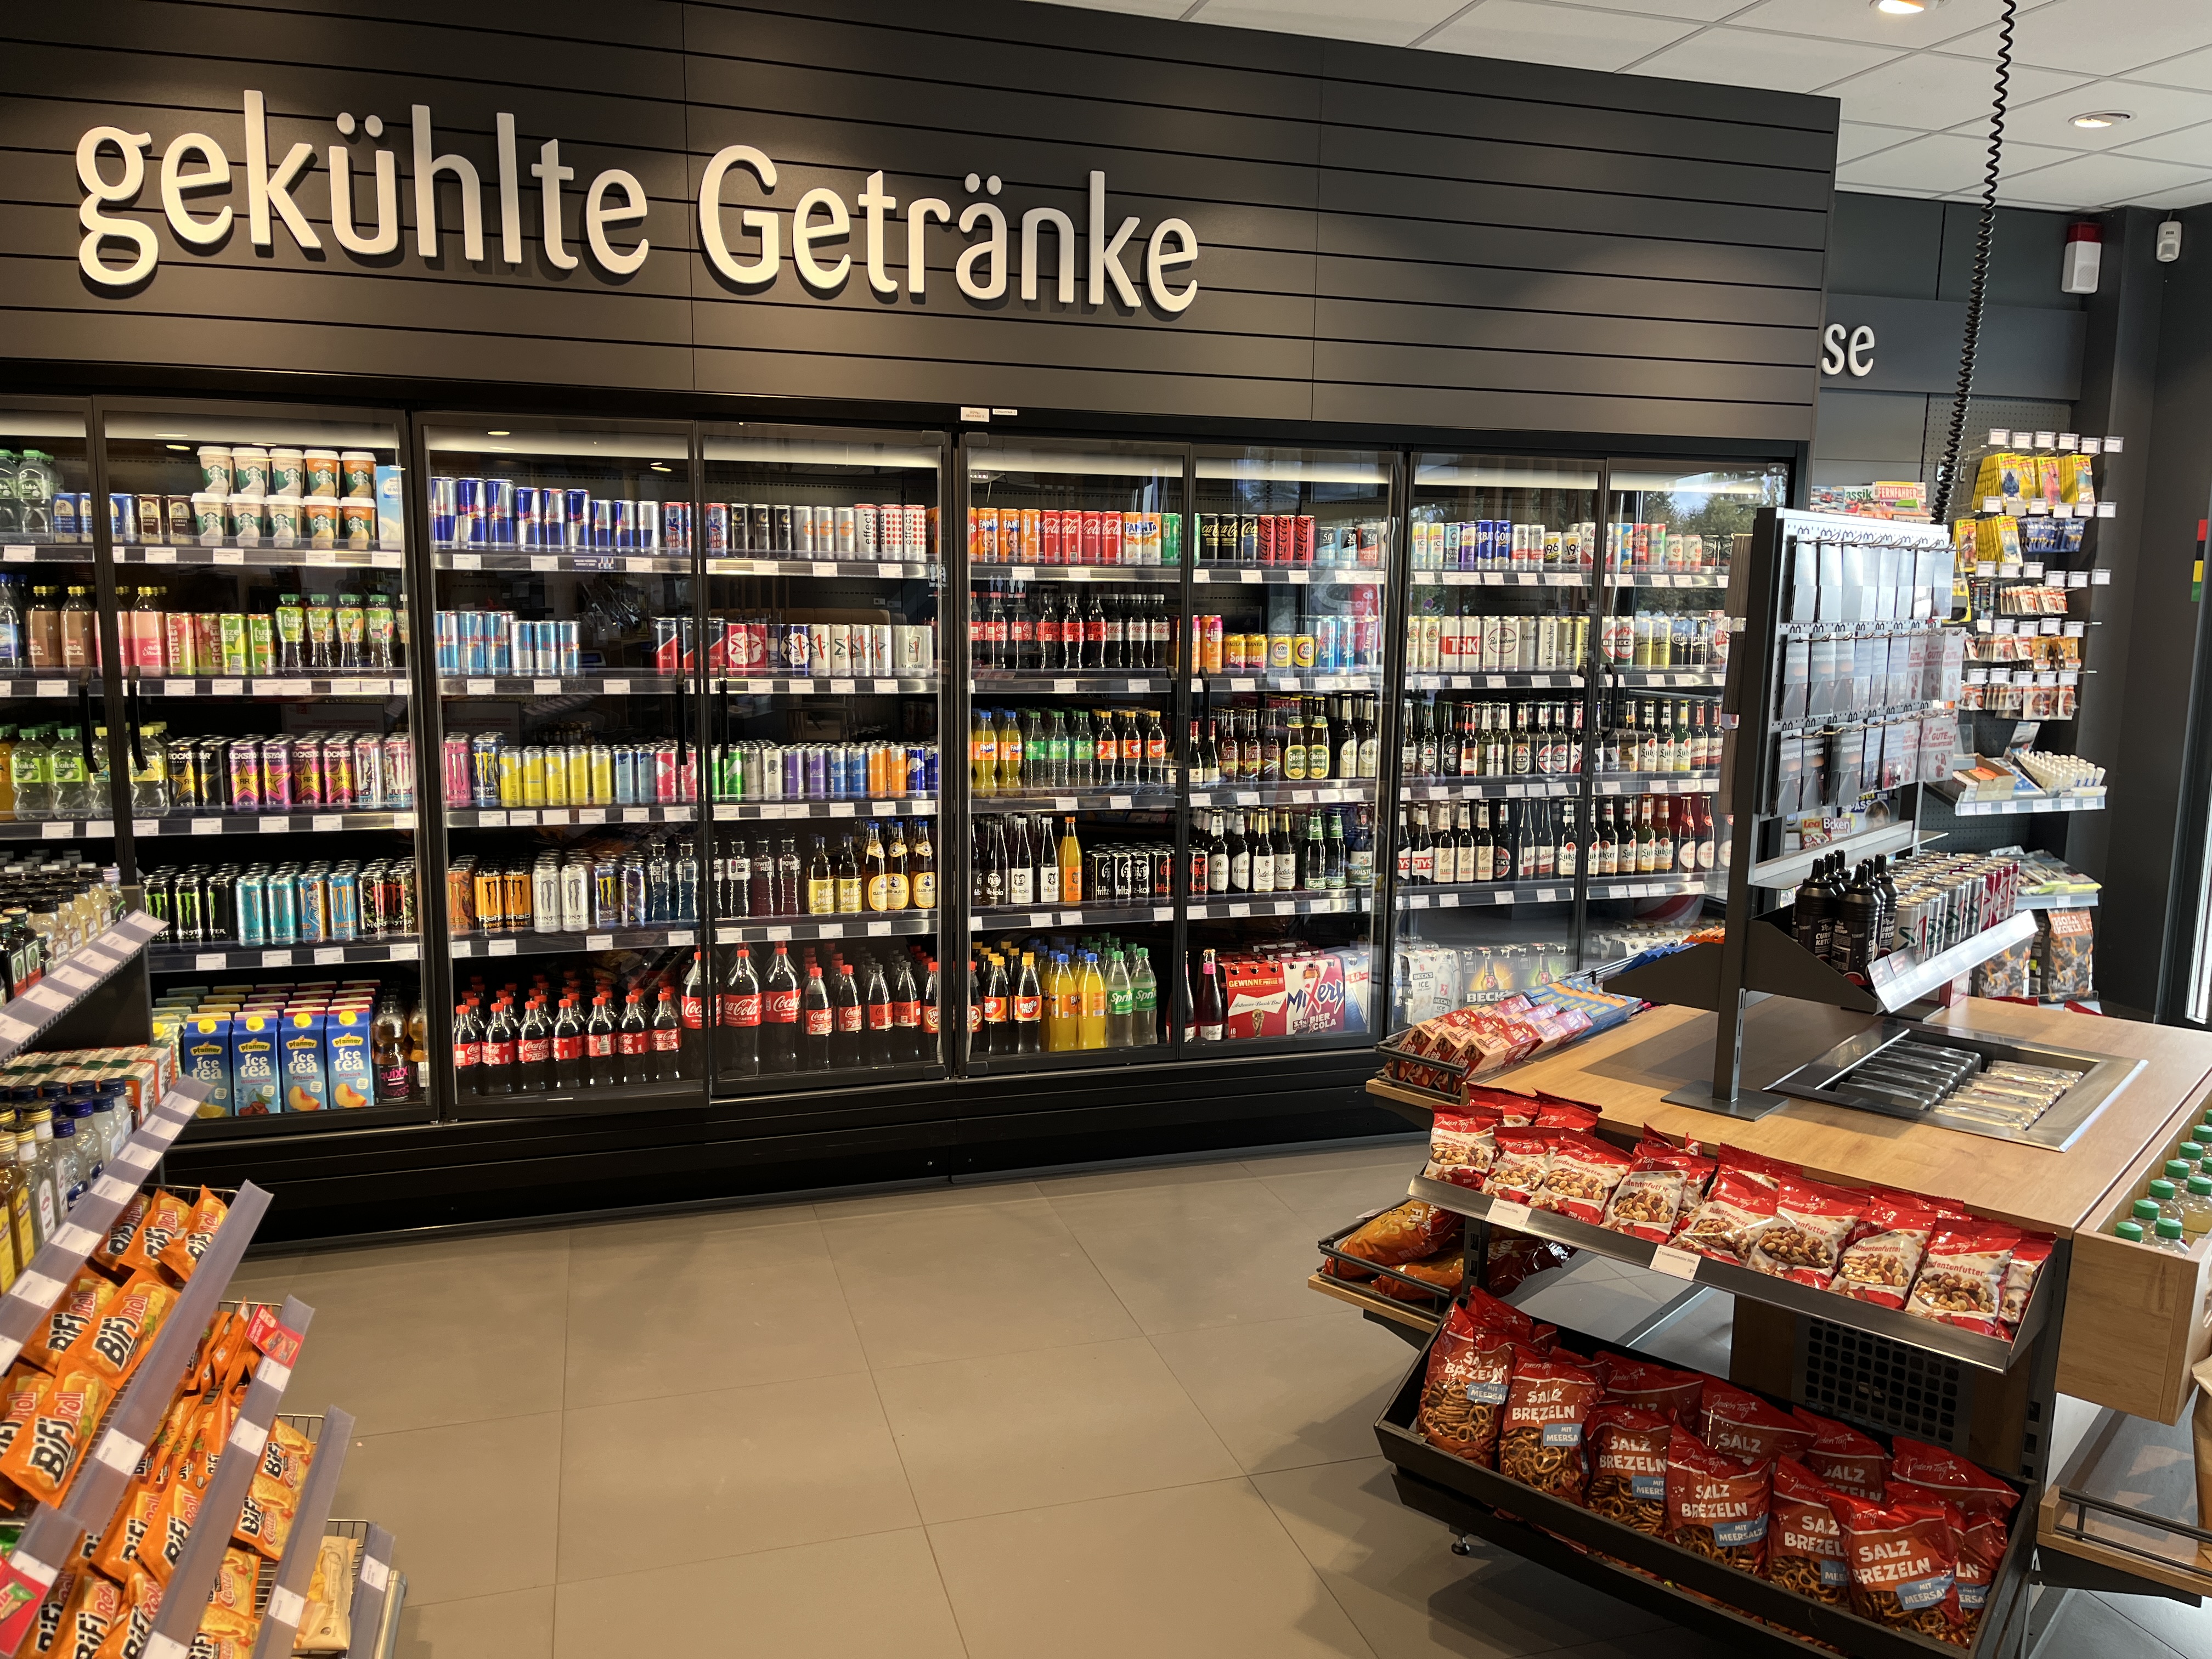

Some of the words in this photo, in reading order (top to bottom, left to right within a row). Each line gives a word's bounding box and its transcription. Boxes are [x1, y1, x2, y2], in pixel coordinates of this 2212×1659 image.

[75, 90, 650, 286] gekühlte
[698, 145, 1200, 313] Getränke
[1932, 732, 1948, 741] GUTE
[1310, 1013, 1330, 1023] BIER
[245, 1053, 268, 1066] ice
[292, 1050, 315, 1063] ice
[338, 1047, 361, 1060] ice
[196, 1057, 219, 1069] ice
[240, 1064, 272, 1077] tea
[287, 1062, 318, 1074] tea
[334, 1059, 364, 1071] tea
[191, 1068, 223, 1080] tea
[1553, 1159, 1605, 1178] Studentenfutter
[156, 1209, 179, 1231] Roll
[1568, 1210, 1579, 1218] 200
[70, 1291, 98, 1318] Roll
[120, 1294, 149, 1323] Roll
[46, 1312, 91, 1353] BiFi
[92, 1314, 140, 1372] BiFi
[1526, 1389, 1563, 1404] SALZ
[7, 1392, 37, 1424] Roll
[54, 1392, 84, 1424] Roll
[1511, 1404, 1575, 1421] BREZELN
[1610, 1435, 1651, 1452] SALZ
[1719, 1432, 1761, 1453] SALZ
[27, 1423, 82, 1487] BiFi
[262, 1441, 284, 1480] BiFi
[1599, 1454, 1667, 1472] BREZELN
[1823, 1466, 1866, 1483] SALZ
[1695, 1483, 1730, 1499] SALZ
[238, 1496, 264, 1537] BiFi
[1681, 1501, 1748, 1519] BREZELN
[1718, 1527, 1764, 1543] MEERSALZ
[1734, 1524, 1747, 1532] MIT
[1858, 1539, 1911, 1562] SALZ
[1854, 1558, 1932, 1584] BREZELN
[1919, 1582, 1932, 1591] MIT
[92, 1582, 116, 1621] Roll
